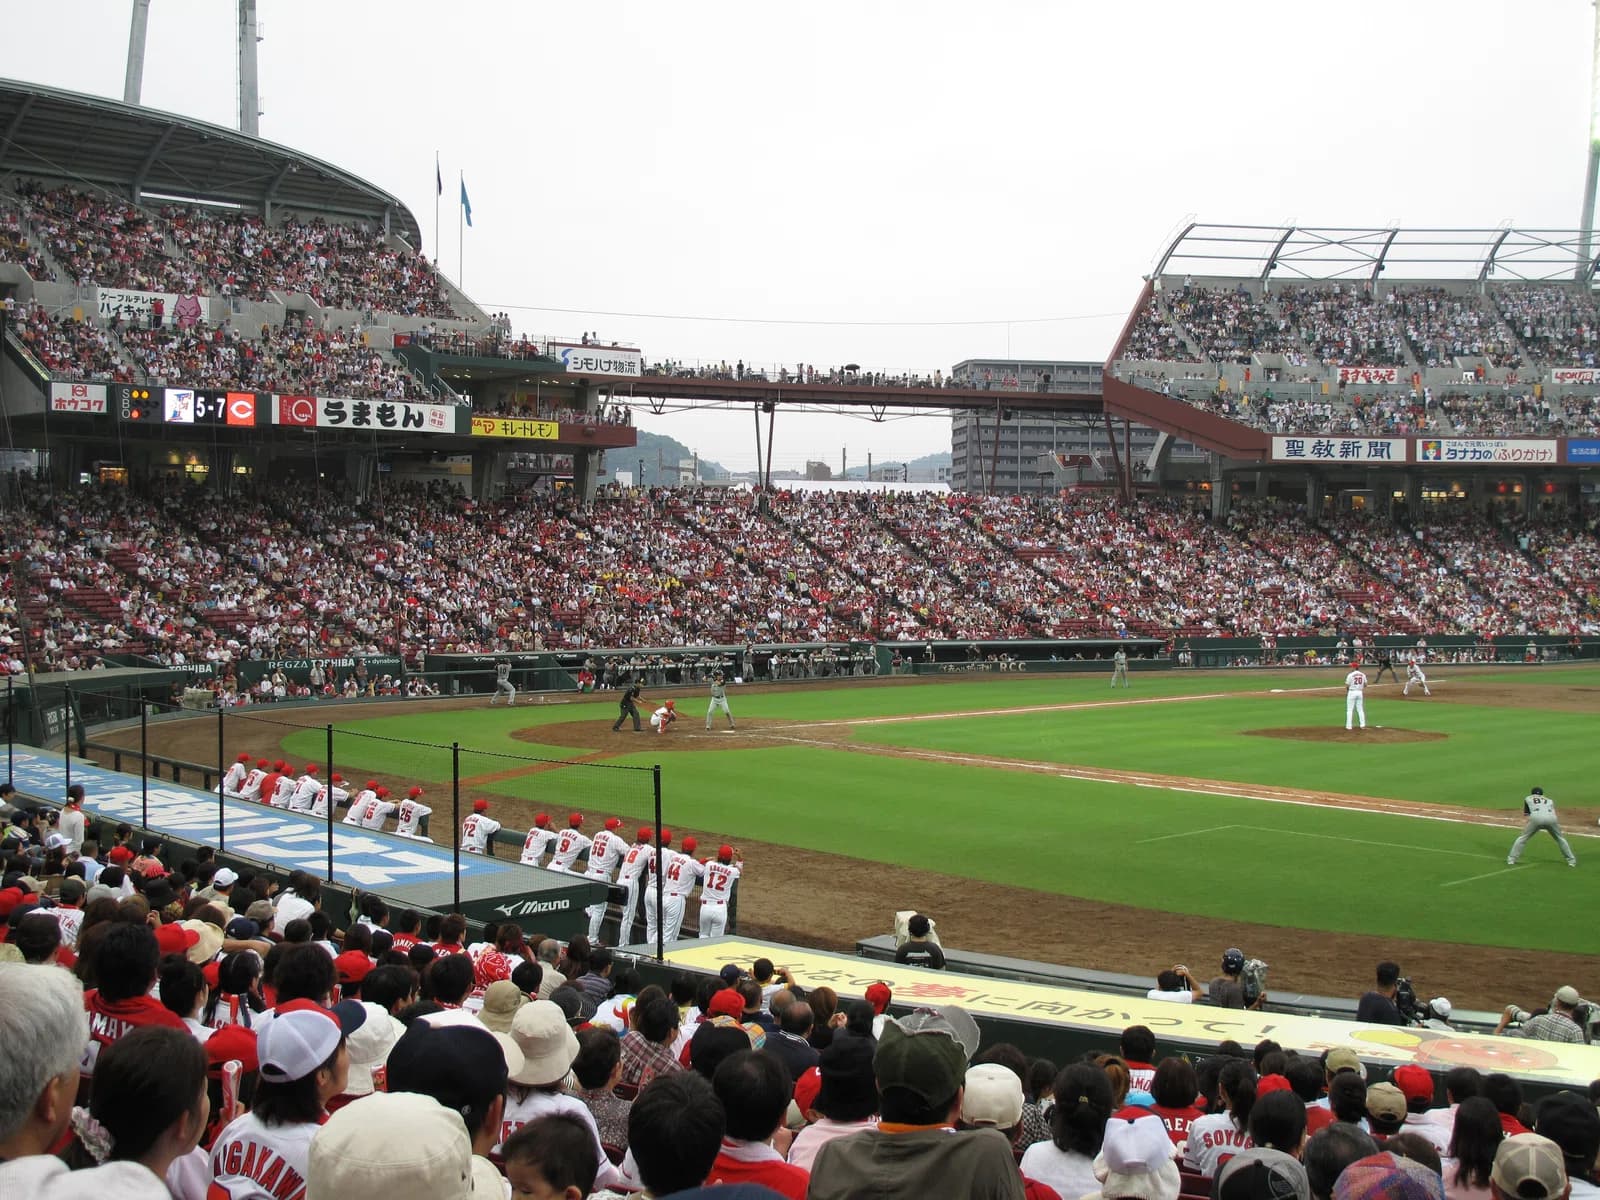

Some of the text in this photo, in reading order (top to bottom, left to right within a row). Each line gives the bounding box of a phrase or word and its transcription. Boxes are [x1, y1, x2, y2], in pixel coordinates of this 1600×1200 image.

[573, 357, 636, 374] シモハナ物流
[122, 389, 129, 398] S
[55, 398, 104, 411] ホウコク
[122, 399, 129, 408] B
[324, 401, 424, 428] うまもん
[502, 421, 553, 437] キレートレモン
[1285, 440, 1392, 459] 聖教新聞
[268, 660, 309, 669] REGZA
[1000, 662, 1027, 672] RCC
[560, 838, 571, 853] 9
[707, 872, 728, 892] 12
